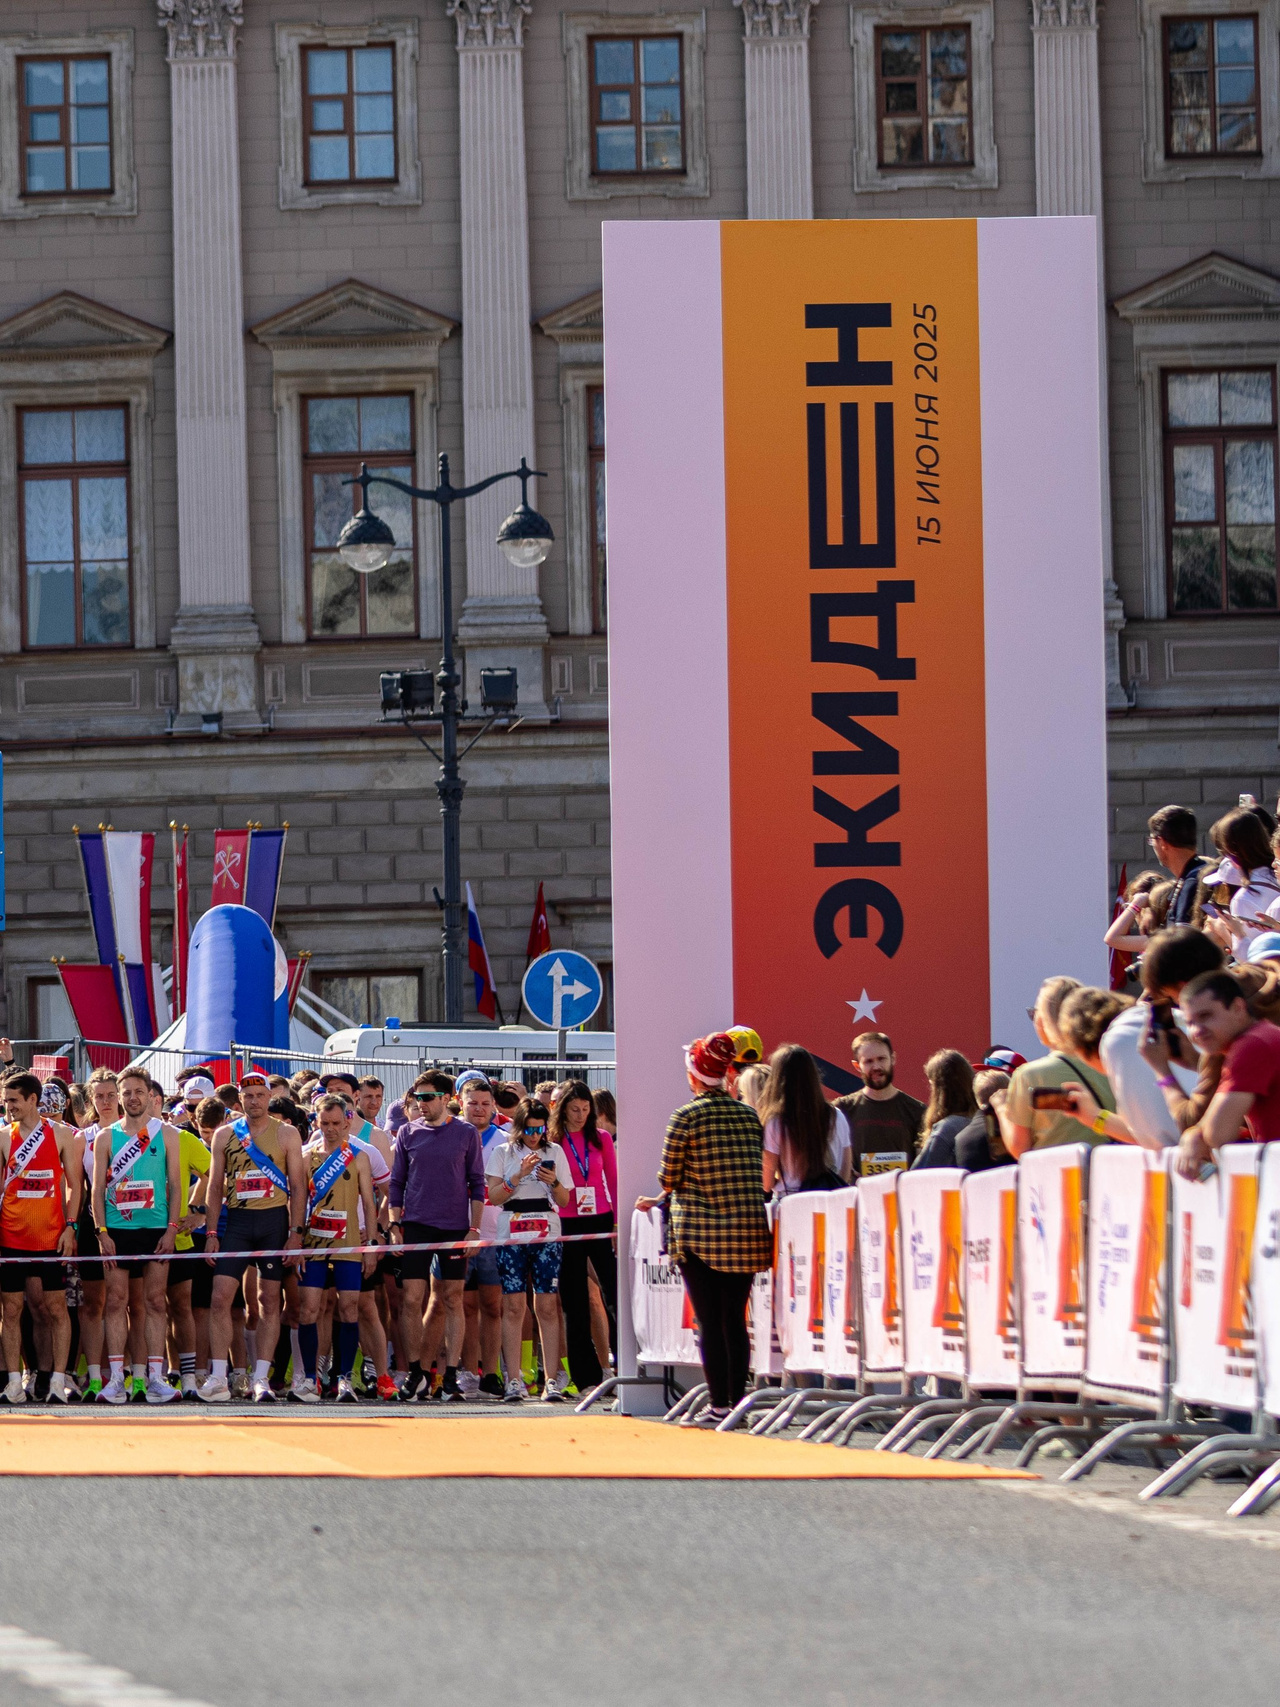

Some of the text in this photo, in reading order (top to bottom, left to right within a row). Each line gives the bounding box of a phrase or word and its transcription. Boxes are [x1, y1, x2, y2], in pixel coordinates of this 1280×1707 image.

[913, 303, 942, 546] 15 ИЮНЯ 2025
[805, 302, 917, 960] ЭКИДЕН
[113, 1134, 150, 1175] ЭКИДЕН
[316, 1147, 353, 1190] ЭКИДЕН
[22, 1181, 49, 1190] 292-1
[121, 1192, 148, 1202] 275-1
[240, 1181, 269, 1191] 394-1
[514, 1221, 543, 1231] 422-1
